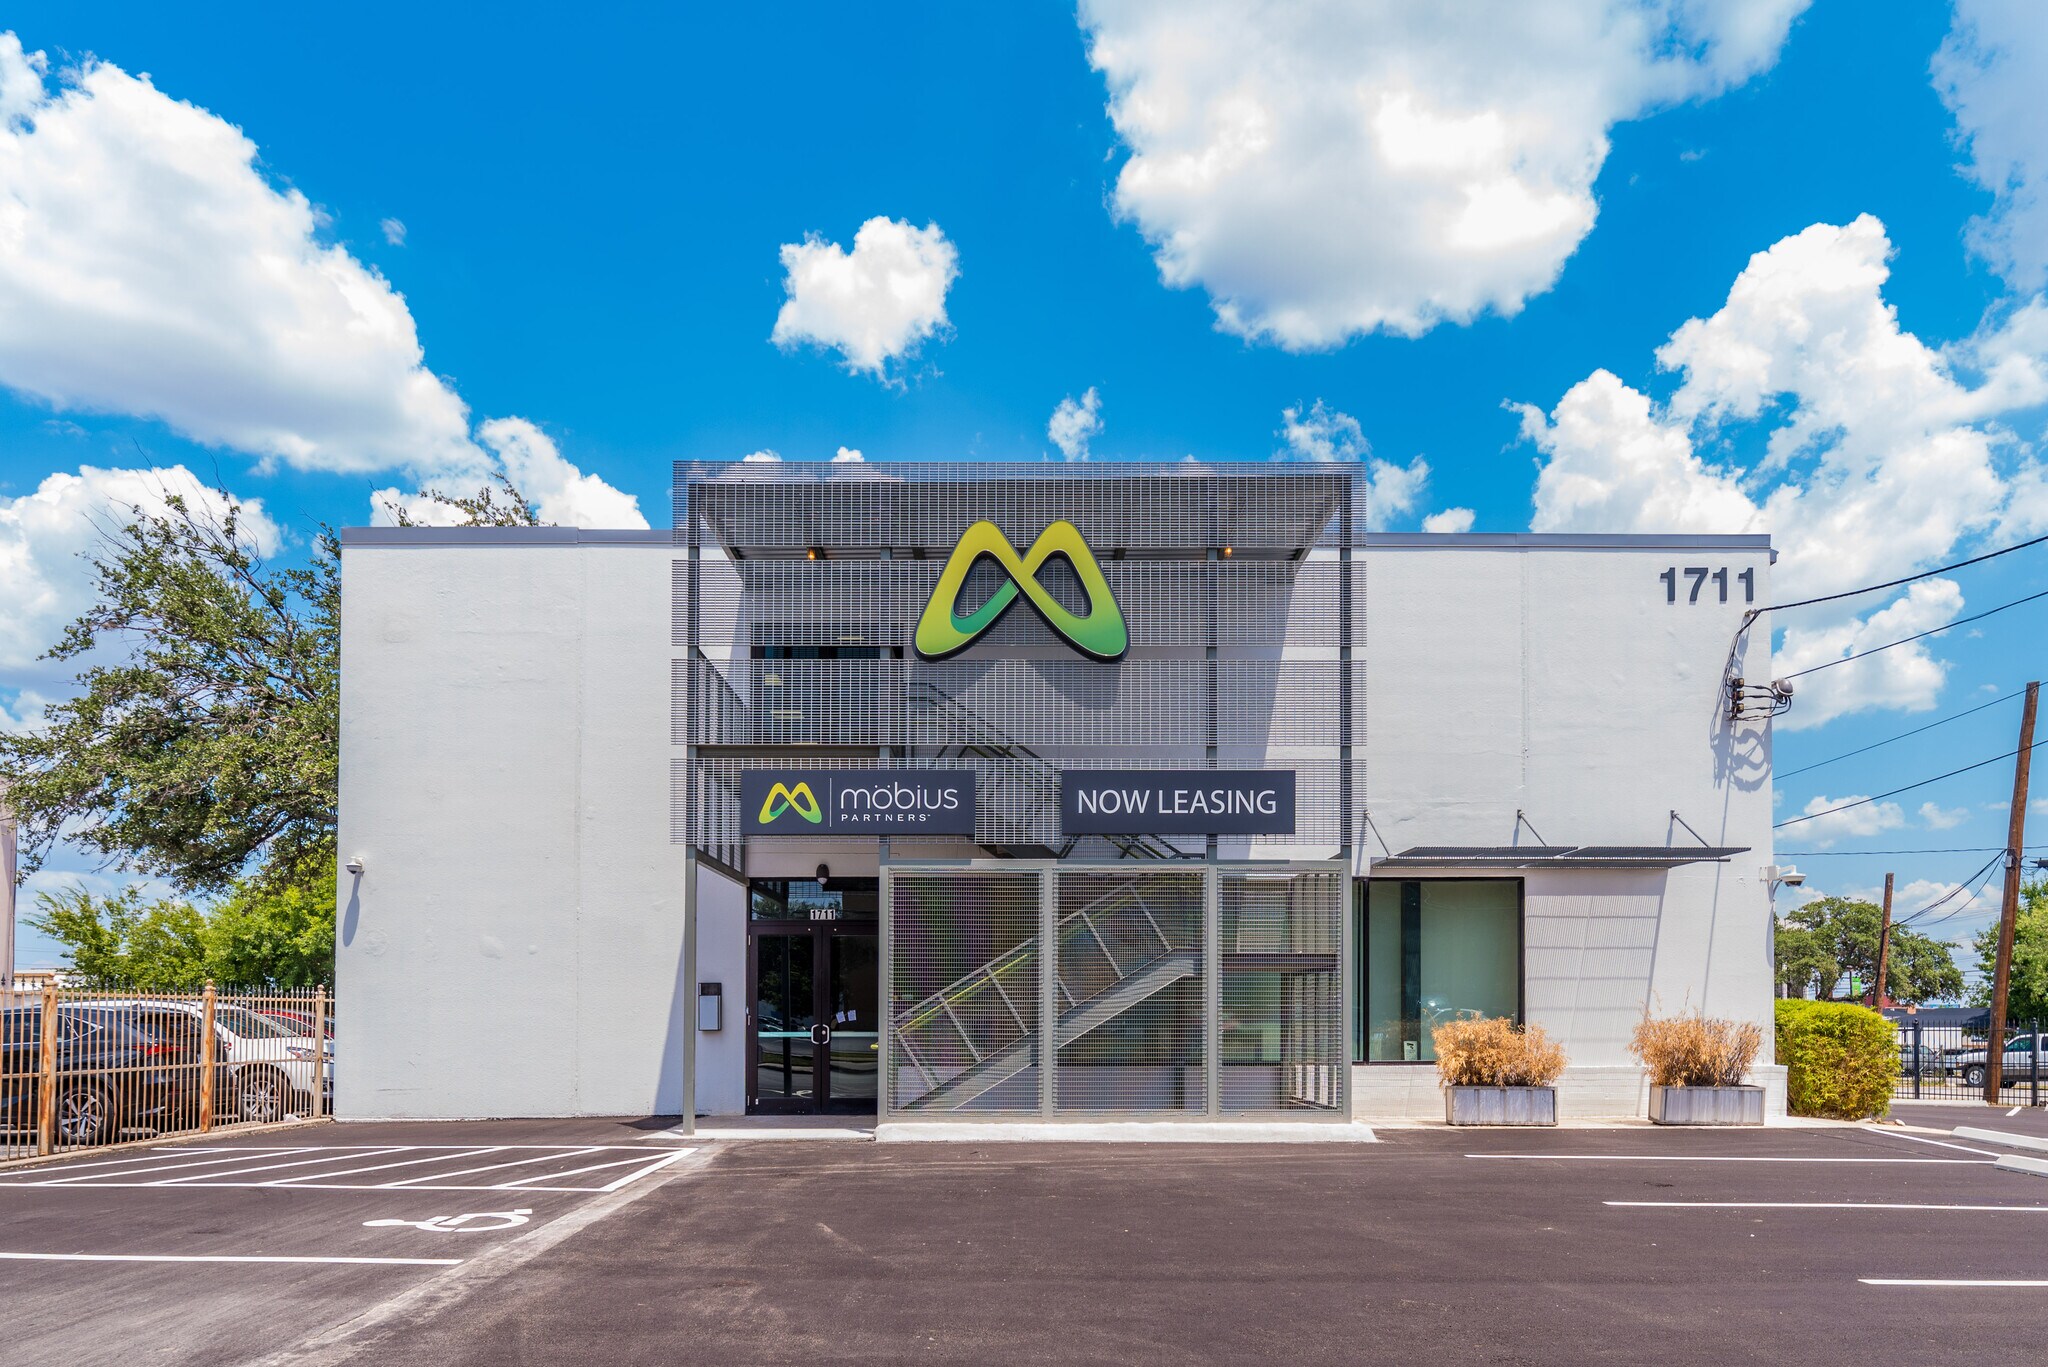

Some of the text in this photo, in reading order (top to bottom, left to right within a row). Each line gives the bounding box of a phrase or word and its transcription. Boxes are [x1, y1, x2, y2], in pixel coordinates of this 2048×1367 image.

[1660, 567, 1754, 602] 1711
[840, 781, 959, 810] möbius
[1078, 789, 1277, 814] NOW LEASING
[841, 813, 927, 822] PARTNERS
[811, 910, 835, 920] 1711
